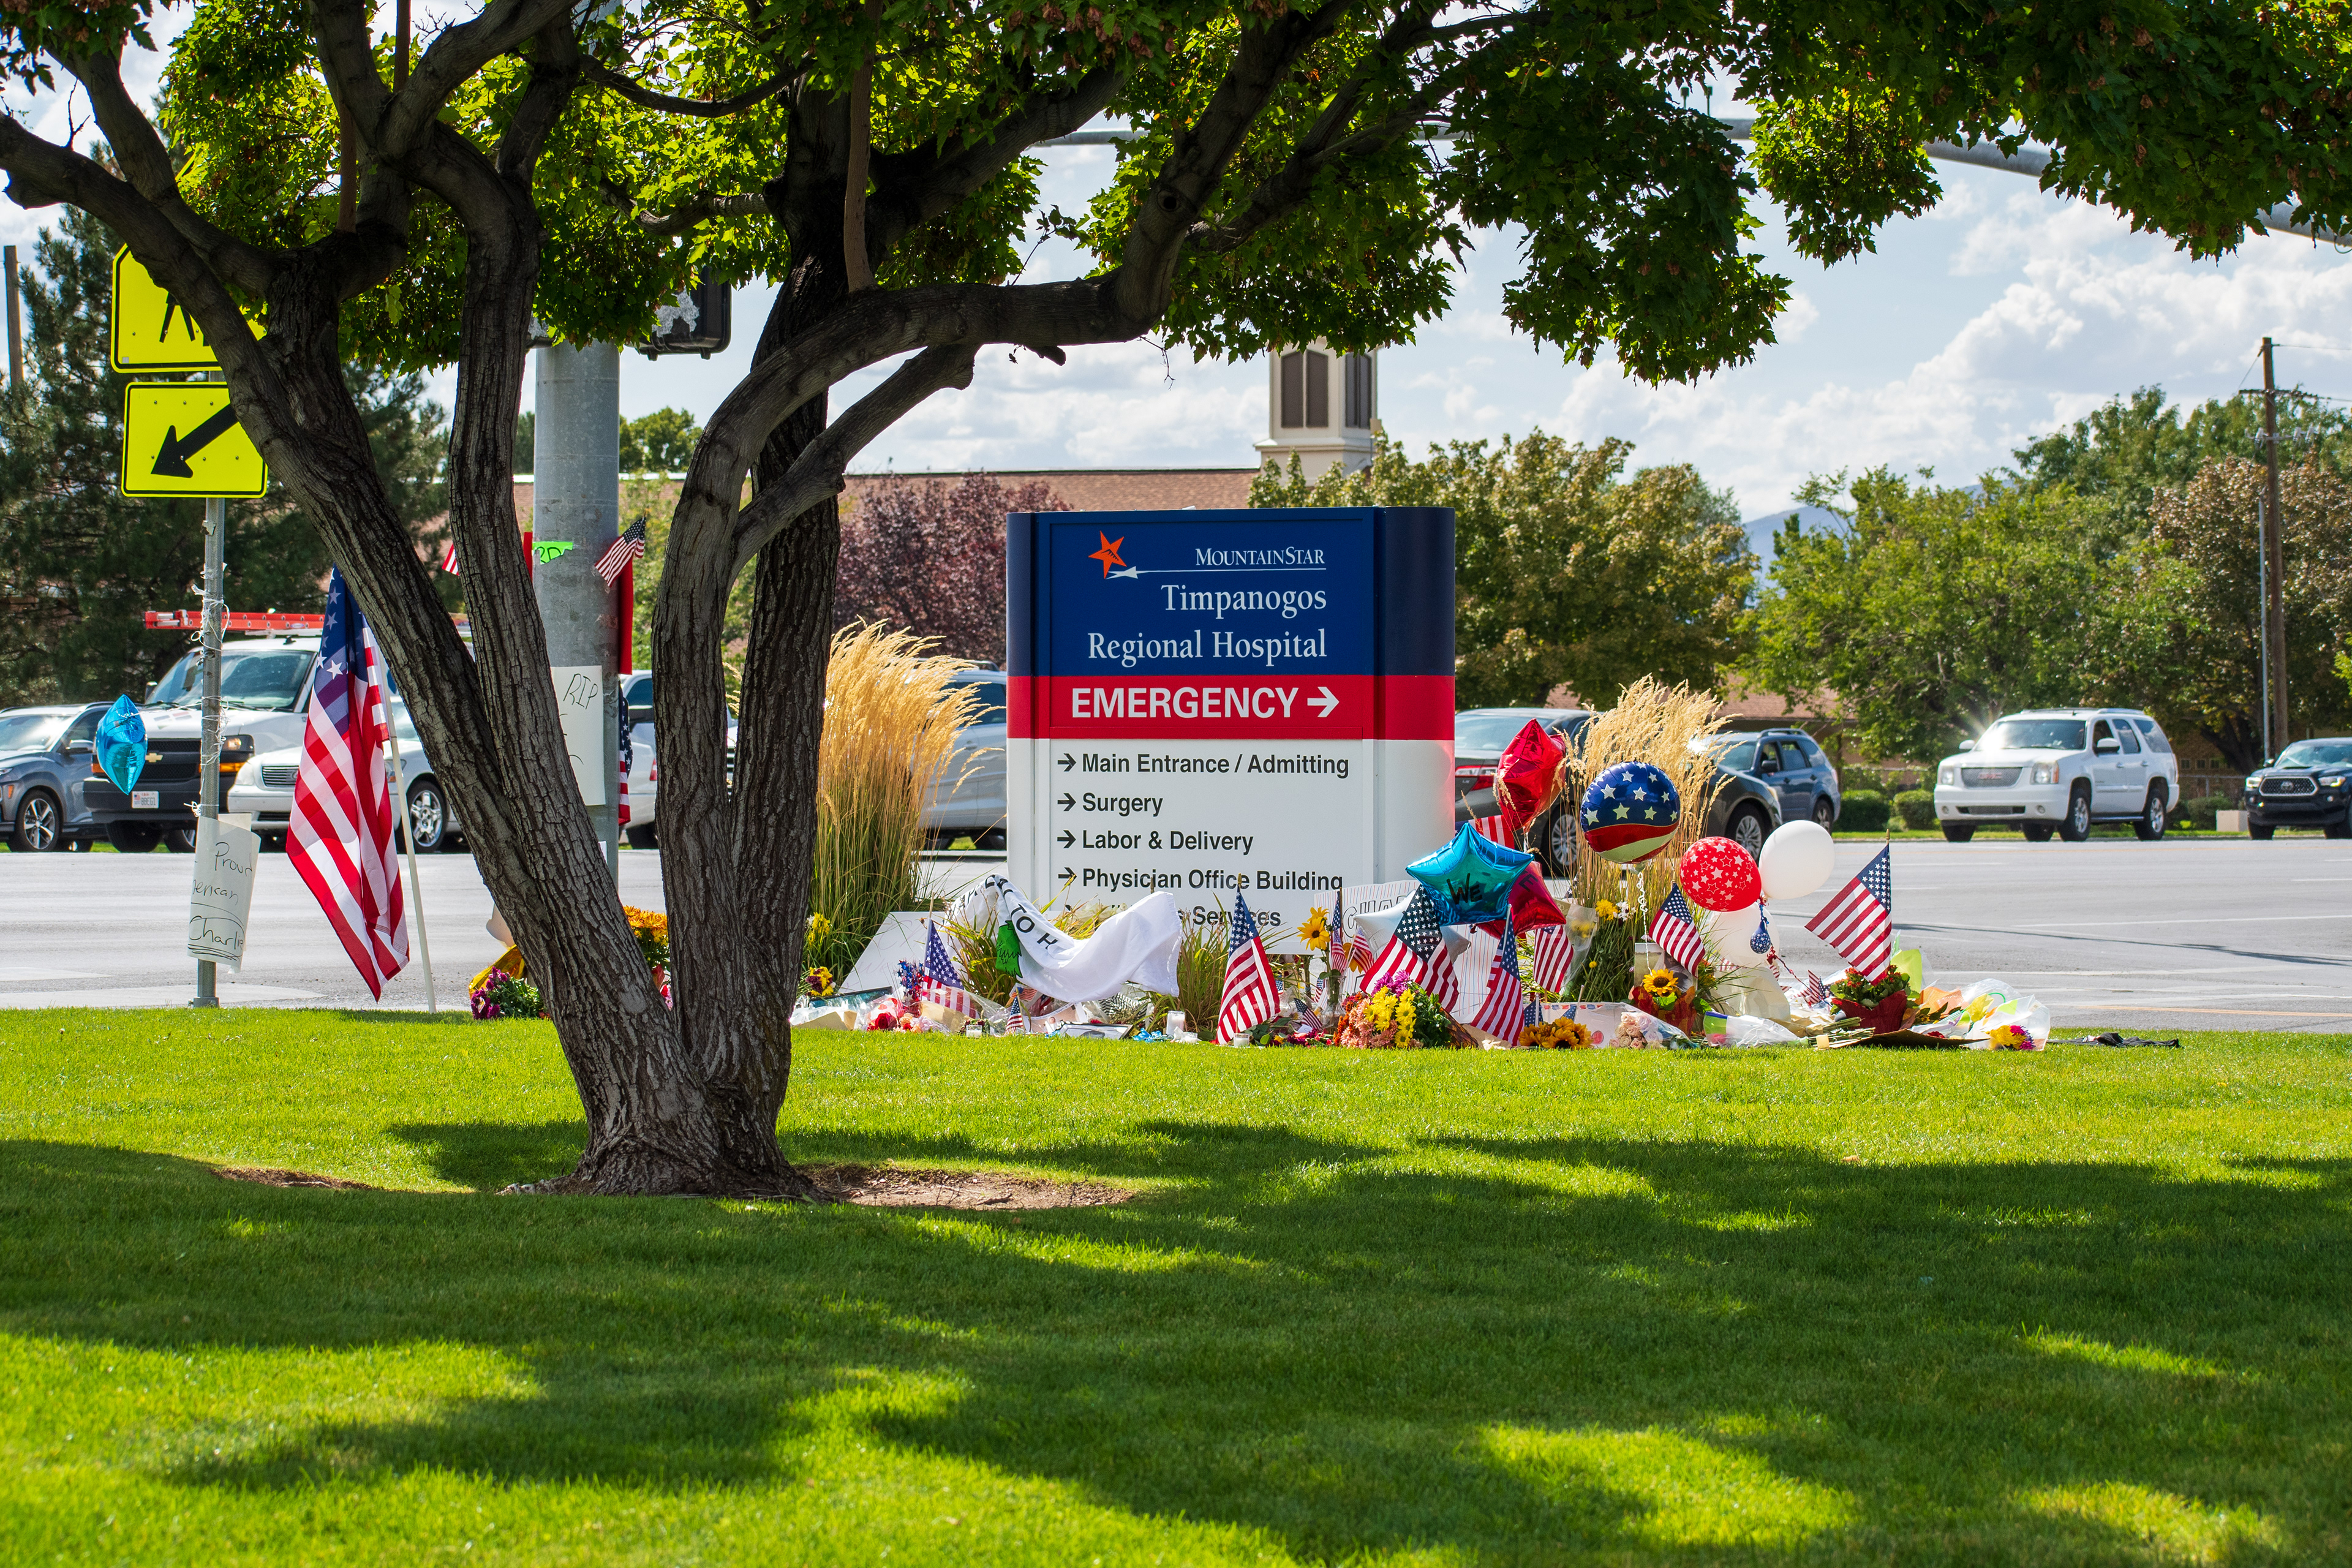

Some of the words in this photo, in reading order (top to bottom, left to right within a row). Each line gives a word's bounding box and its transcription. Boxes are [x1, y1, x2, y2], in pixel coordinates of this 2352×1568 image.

[1161, 584, 1327, 619] Timpanogos
[1087, 629, 1204, 668] Regional
[1212, 628, 1327, 667] Hospital
[563, 673, 598, 710] RIP
[1072, 687, 1299, 718] EMERGENCY
[1082, 753, 1129, 772] Main
[1137, 753, 1230, 774] Entrance
[1234, 753, 1243, 773] /
[1247, 754, 1349, 779] Admitting
[1082, 792, 1163, 817] Surgery
[1083, 830, 1142, 850] Labor
[1148, 831, 1163, 850] &
[1170, 831, 1254, 856] Delivery
[1083, 868, 1182, 892] Physician
[1188, 869, 1250, 889] Office
